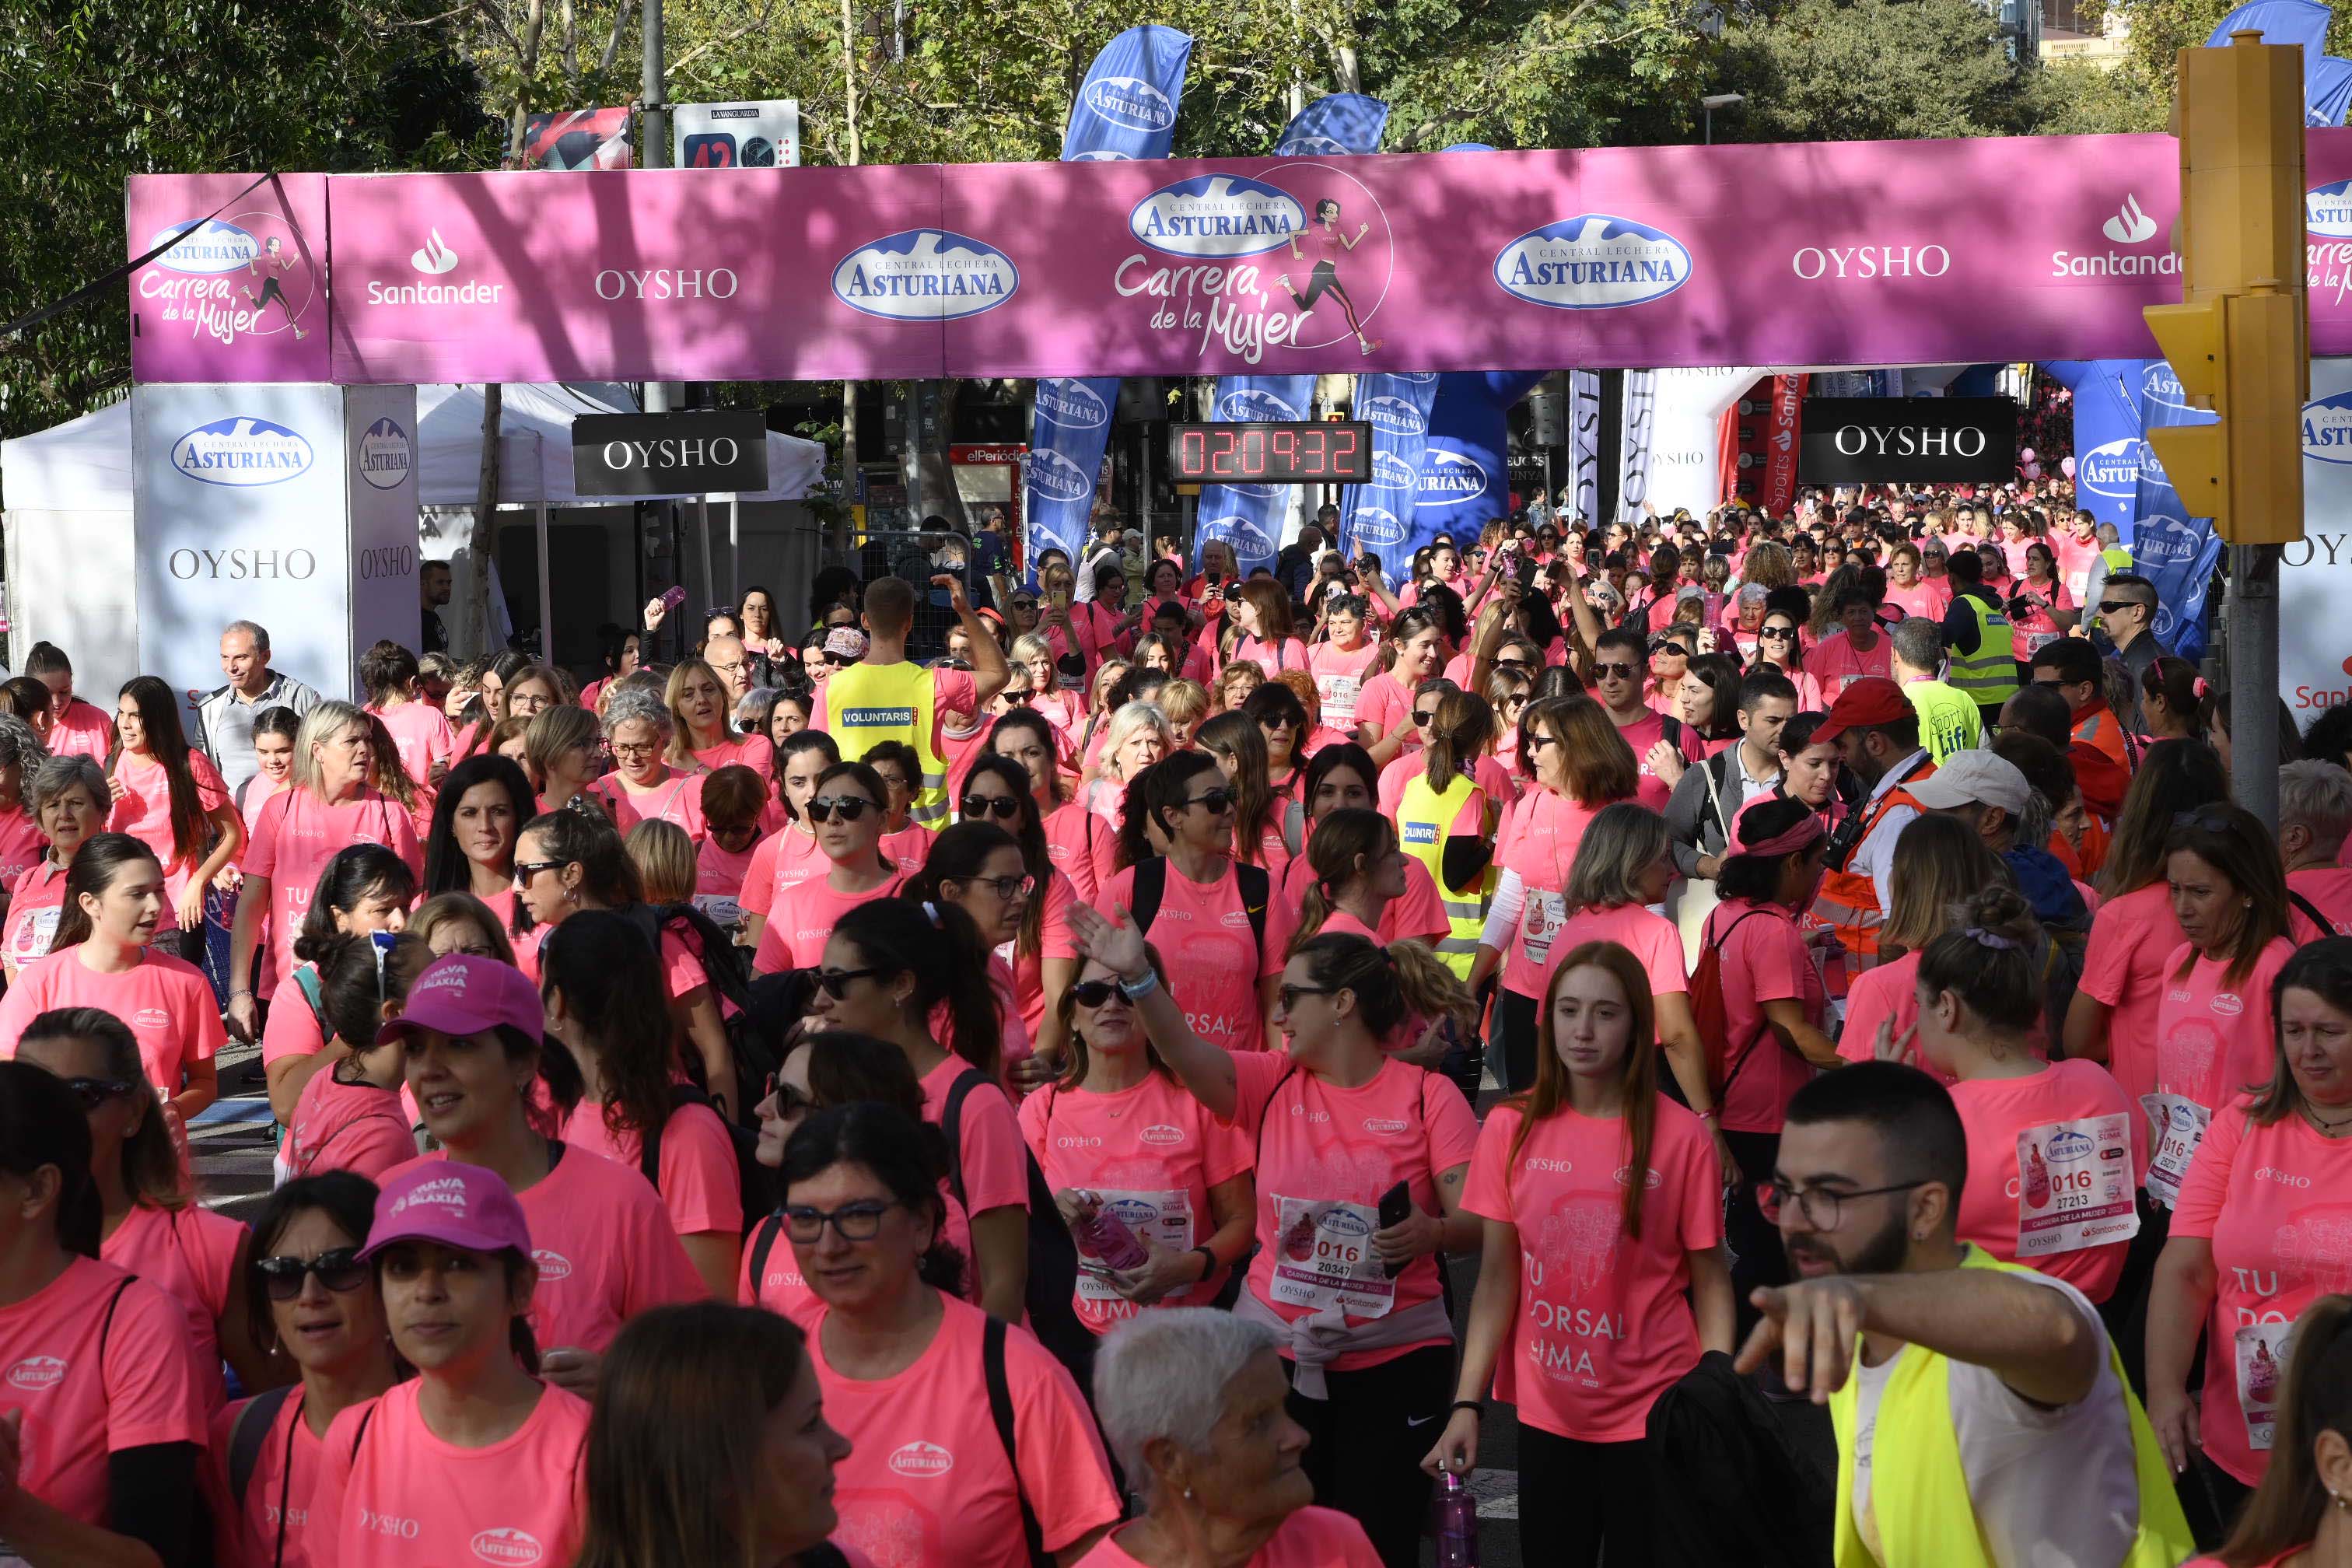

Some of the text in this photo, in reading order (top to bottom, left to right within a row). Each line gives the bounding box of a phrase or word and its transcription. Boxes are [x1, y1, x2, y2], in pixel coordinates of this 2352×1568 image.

[720, 110, 758, 118] VANGUARDIA
[1090, 86, 1165, 125] ASTURIANA
[1170, 201, 1288, 212] CENTRAL LECHERA
[1143, 205, 1292, 237] ASTURIANA
[1540, 246, 1671, 257] CENTRAL LECHERA
[1792, 245, 1951, 279] OYSHO
[874, 261, 998, 271] CENTRAL LECHERA
[1115, 254, 1262, 297] Carrera
[1509, 250, 1676, 285] ASTURIANA
[2052, 251, 2183, 277] Santand
[140, 270, 233, 299] Carrera
[595, 268, 737, 300] OYSHO
[846, 264, 1005, 297] ASTURIANA
[2325, 265, 2338, 287] la
[367, 280, 503, 306] Santander
[162, 296, 265, 345] de la Mujer
[1150, 291, 1314, 365] de la Mujer
[1363, 405, 1421, 431] ASTURIANA
[1183, 432, 1355, 473] 02:09:32
[1835, 425, 1986, 457] OYSHO
[182, 443, 303, 468] ASTURIANA
[363, 445, 408, 471] ASTURIANA
[604, 437, 738, 471] OYSHO
[968, 450, 1021, 462] elPeriódi
[1769, 455, 1790, 508] Sports
[2087, 460, 2138, 483] ASTUR
[1419, 476, 1479, 492] URIANA
[2280, 534, 2352, 566] OY
[169, 549, 316, 579] OYSHO
[360, 545, 412, 580] OYSHO
[844, 712, 910, 723] VOLUNTARIS
[1930, 709, 1963, 737] Sport
[1938, 726, 1967, 758] Life
[777, 869, 809, 879] OYSHO
[285, 887, 308, 905] TU
[1546, 921, 1563, 932] 01
[37, 934, 52, 944] 01
[1185, 1013, 1236, 1036] RSAL
[2098, 1131, 2123, 1142] SUMA
[2164, 1137, 2185, 1157] 016
[2048, 1144, 2091, 1157] ASTURIANA
[1525, 1158, 1573, 1173] OYSHO
[2255, 1166, 2310, 1188] OYSHO
[2053, 1170, 2092, 1192] 016
[2056, 1195, 2089, 1209] 27213
[1320, 1216, 1366, 1234] ASTURIANA
[2032, 1216, 2061, 1227] CARRERA
[2061, 1213, 2070, 1223] DE
[2071, 1212, 2081, 1220] LA
[2081, 1209, 2106, 1220] MUJER
[2028, 1222, 2130, 1248] OYSHO Santander
[1317, 1241, 1359, 1262] 016
[768, 1273, 807, 1286] OYSH
[1286, 1270, 1318, 1283] CARRERA
[1319, 1276, 1330, 1285] DE
[1330, 1278, 1341, 1286] LA
[1341, 1280, 1364, 1290] MUJER
[1317, 1262, 1351, 1276] 20347
[1082, 1283, 1115, 1292] OYSH
[2231, 1266, 2278, 1297] TU
[1279, 1284, 1384, 1310] OYSHO Santander
[894, 1455, 948, 1469] ASTURIANA
[477, 1538, 538, 1560] ASTURIANA
